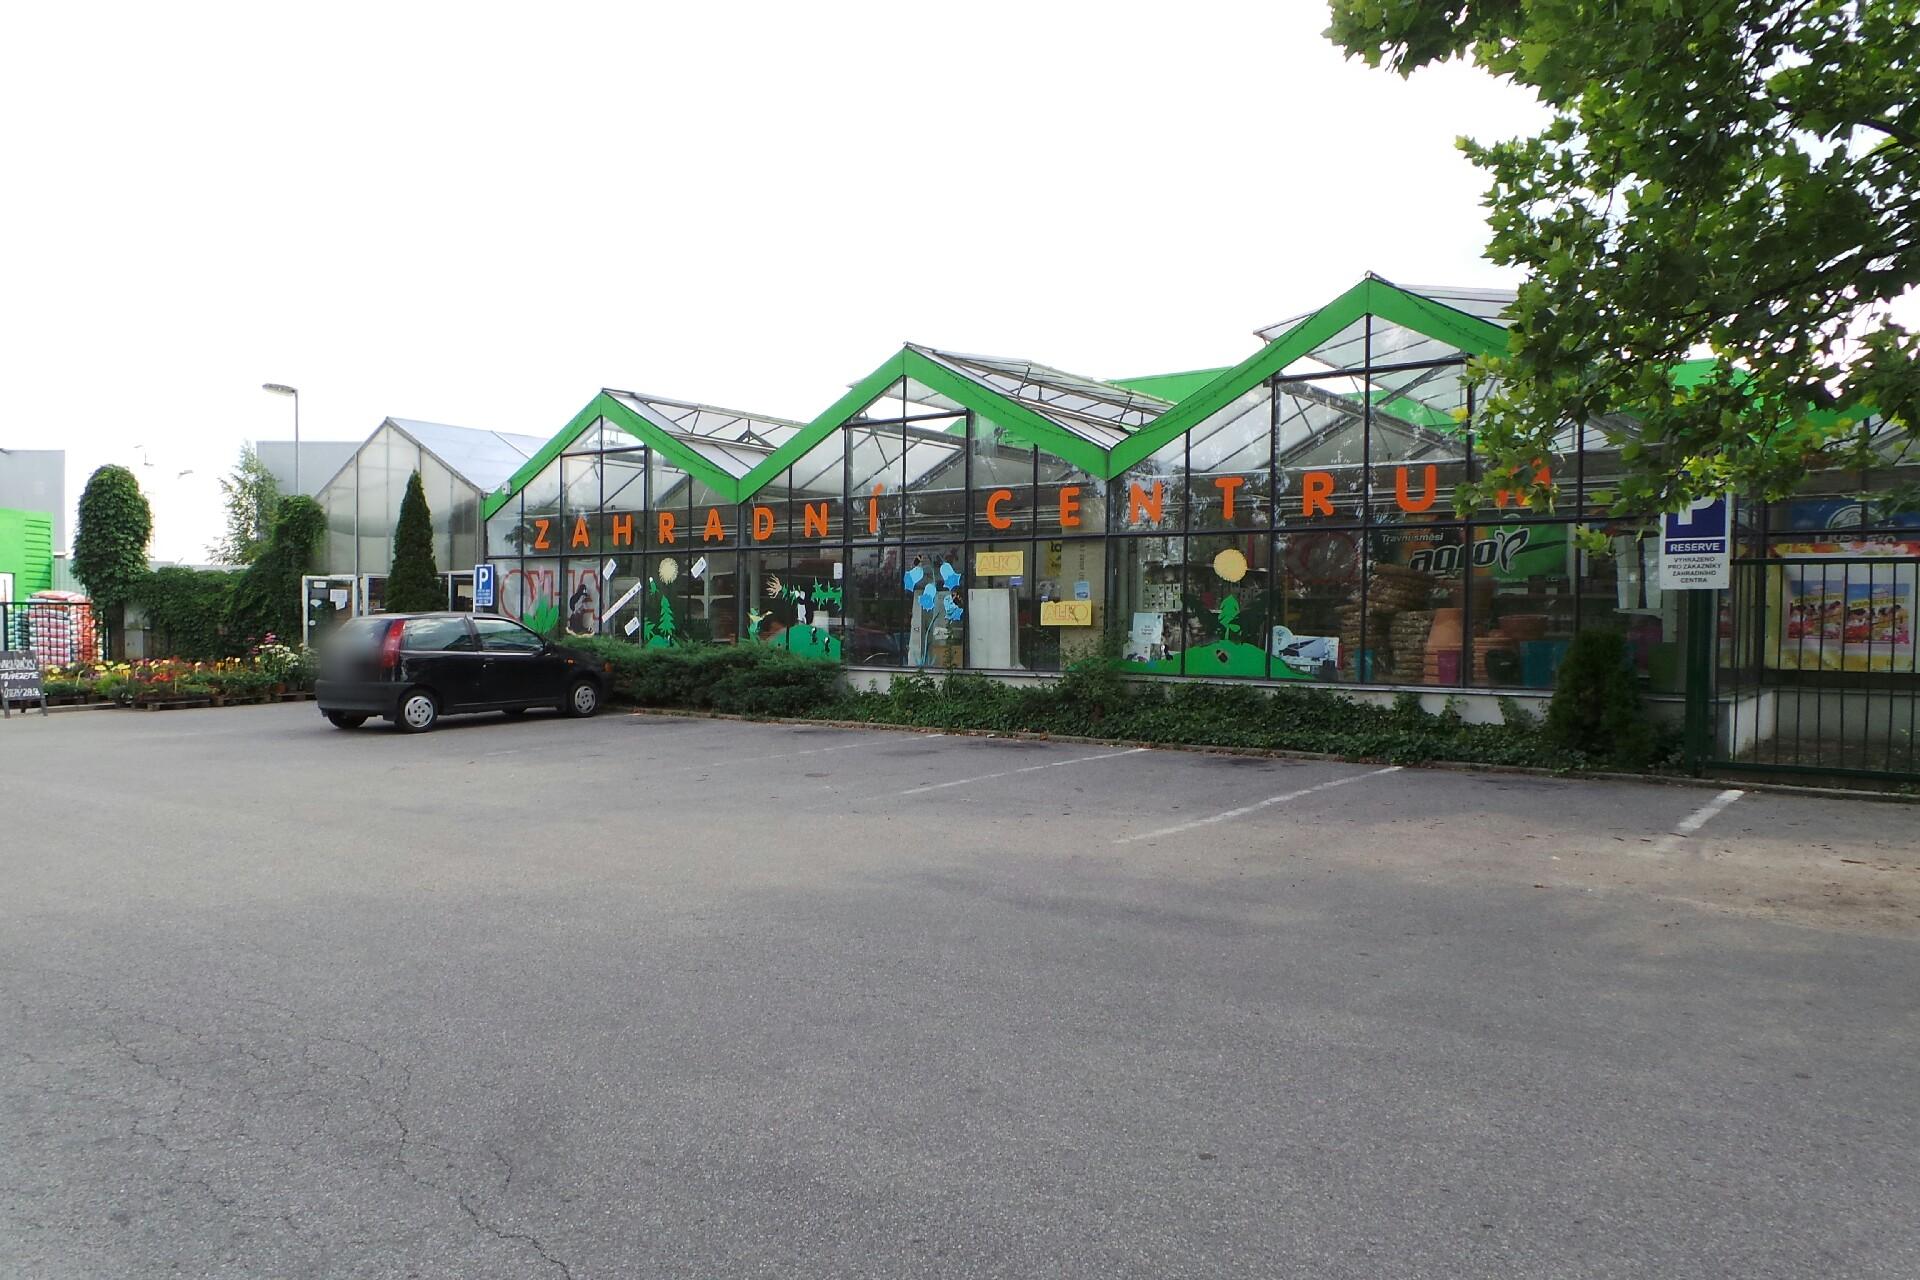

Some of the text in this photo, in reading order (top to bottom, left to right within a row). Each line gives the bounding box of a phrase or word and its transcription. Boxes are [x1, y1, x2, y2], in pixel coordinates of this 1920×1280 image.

[534, 483, 884, 549] ZAHRADNÍ
[1670, 542, 1720, 552] RESERVE
[479, 568, 489, 590] P
